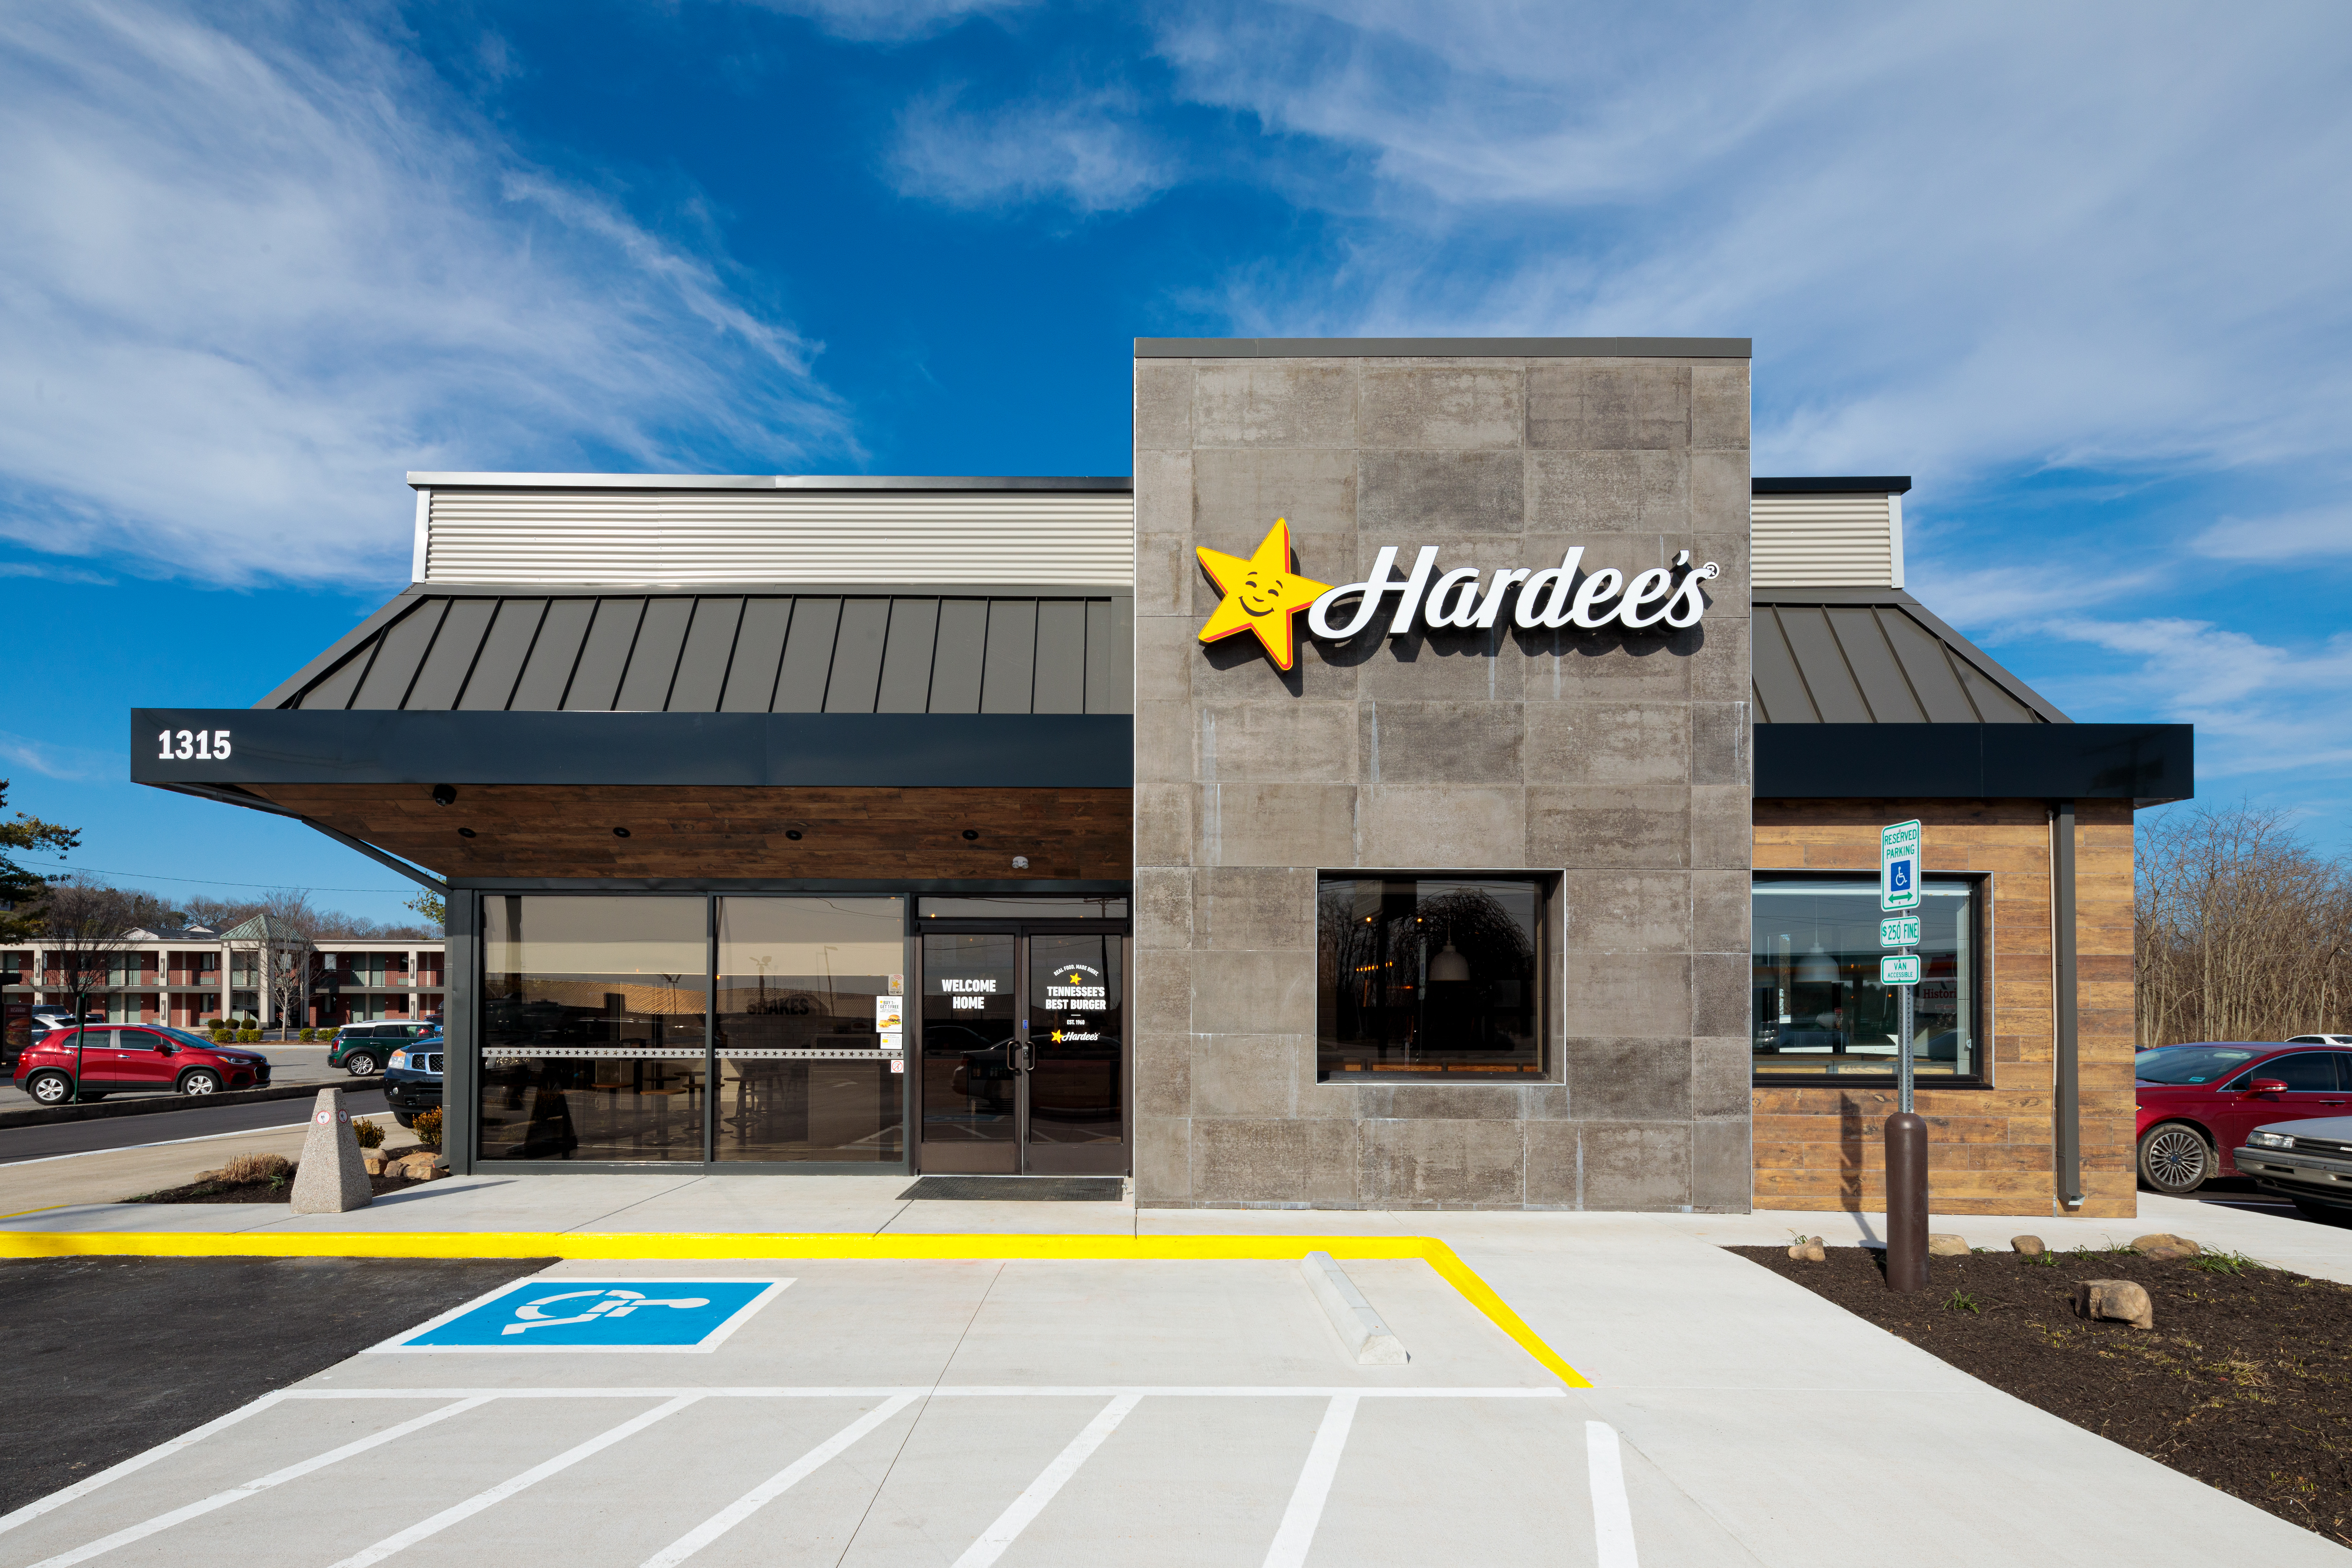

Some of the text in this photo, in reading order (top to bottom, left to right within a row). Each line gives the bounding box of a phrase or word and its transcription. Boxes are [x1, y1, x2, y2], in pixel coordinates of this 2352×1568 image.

[159, 730, 231, 759] 1315
[1885, 829, 1917, 846] RESERVED
[1886, 844, 1915, 859] PARKING
[1882, 923, 1918, 940] $250 FINE
[1053, 968, 1064, 976] REAL
[1087, 966, 1099, 976] RIGHT.
[1894, 962, 1907, 970] VAN
[941, 979, 996, 992] WELCOME
[1047, 986, 1105, 997] TENNESSEE'S
[746, 998, 809, 1015] SHAKES
[953, 996, 984, 1009] HOME
[1046, 999, 1106, 1010] BEST BURGER
[1061, 1032, 1099, 1041] Hardee's
